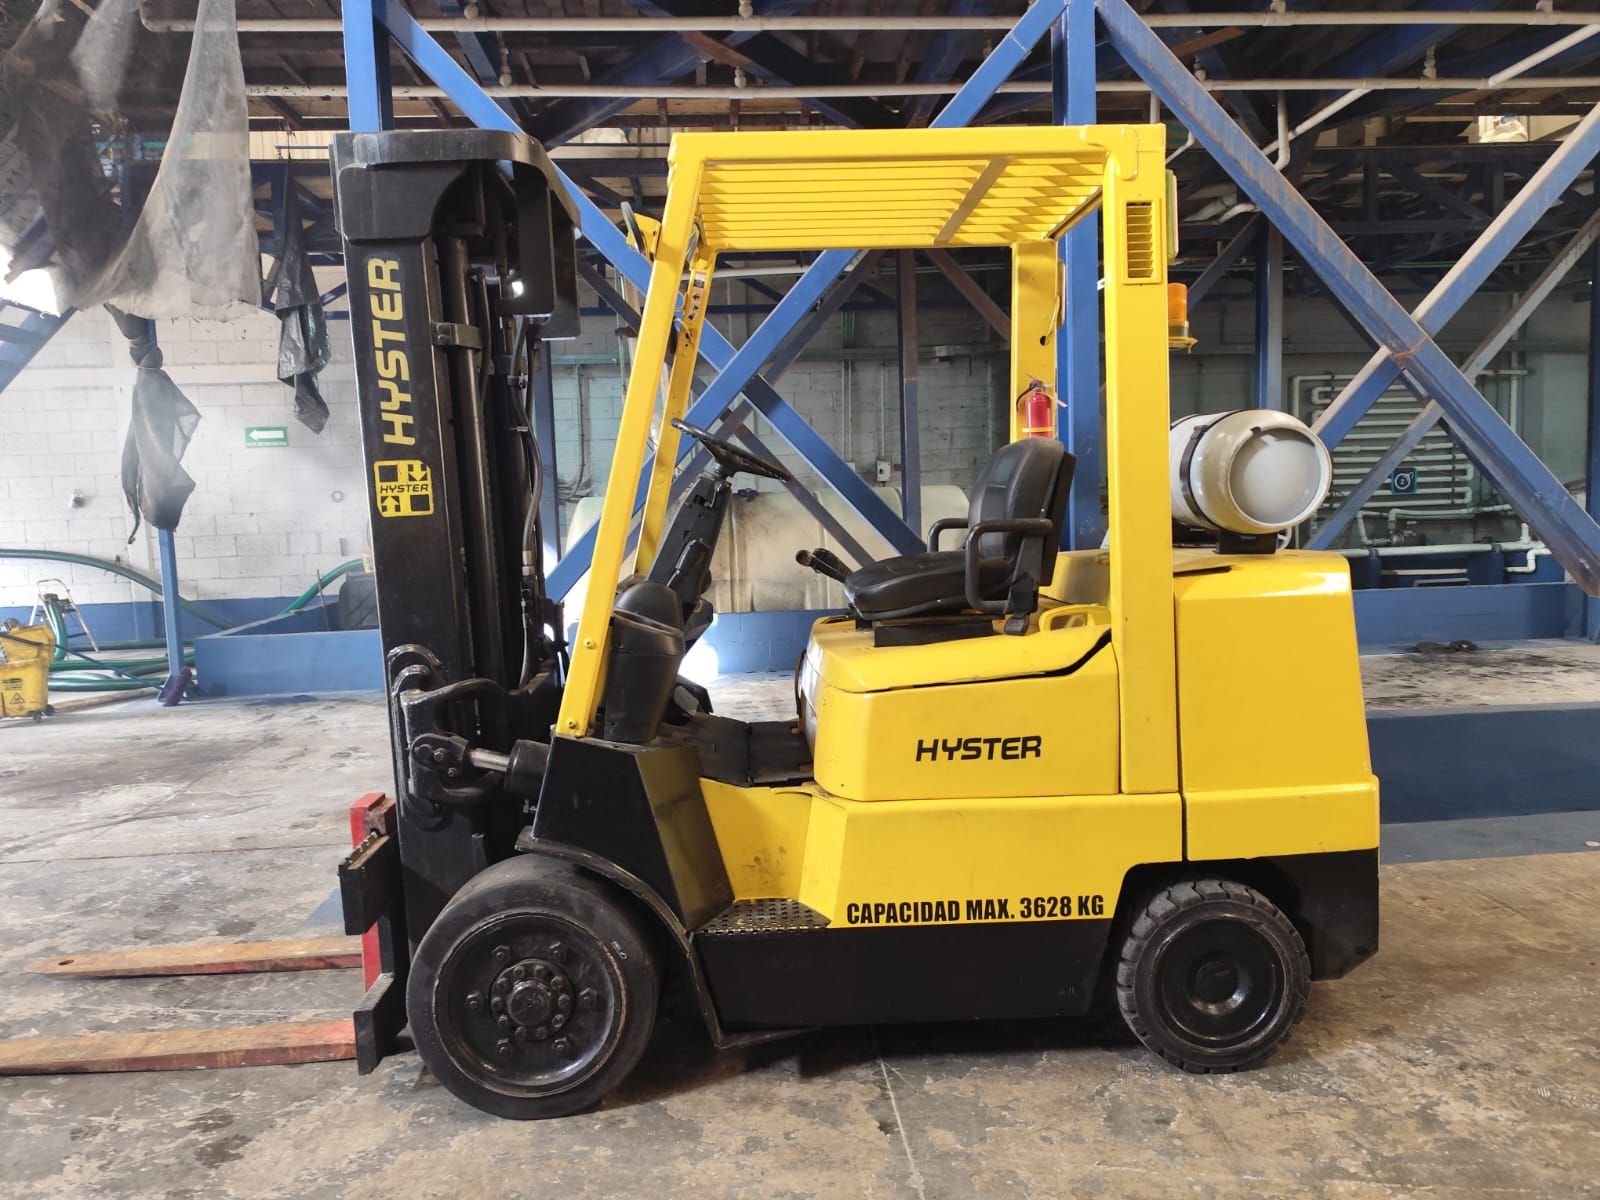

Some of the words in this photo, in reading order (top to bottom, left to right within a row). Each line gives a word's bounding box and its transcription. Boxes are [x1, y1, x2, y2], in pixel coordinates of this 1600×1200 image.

[367, 257, 416, 446] HYSTER
[380, 483, 429, 494] HYSTER
[915, 735, 1042, 762] HYSTER
[847, 900, 961, 925] CAPACIDAD
[966, 898, 1015, 921] MAX.
[1020, 896, 1072, 919] 3628
[1078, 894, 1105, 916] KG
